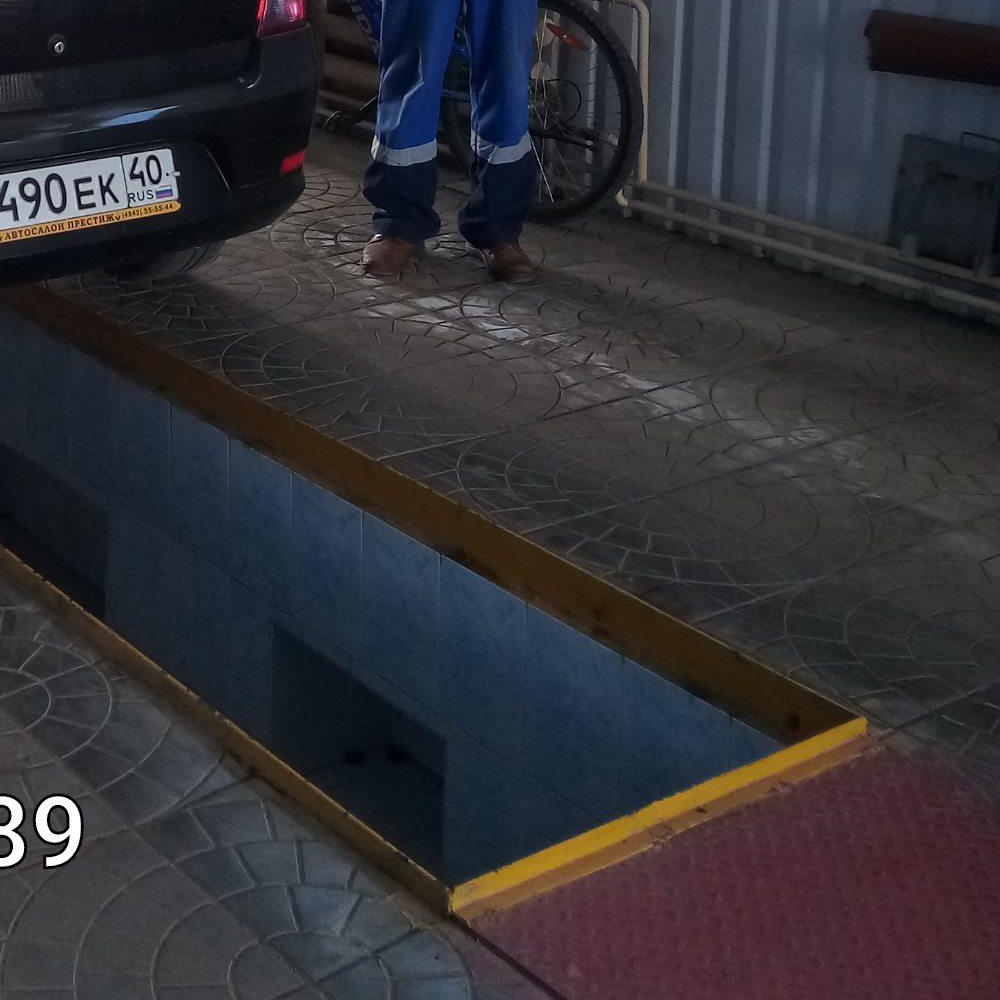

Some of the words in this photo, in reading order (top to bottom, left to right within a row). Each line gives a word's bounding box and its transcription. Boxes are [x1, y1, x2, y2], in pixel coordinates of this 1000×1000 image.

[129, 154, 163, 187] 40
[128, 189, 155, 203] RUS
[4, 222, 65, 241] АВТОСАЛОН
[67, 213, 115, 230] ПРЕСТИЖ
